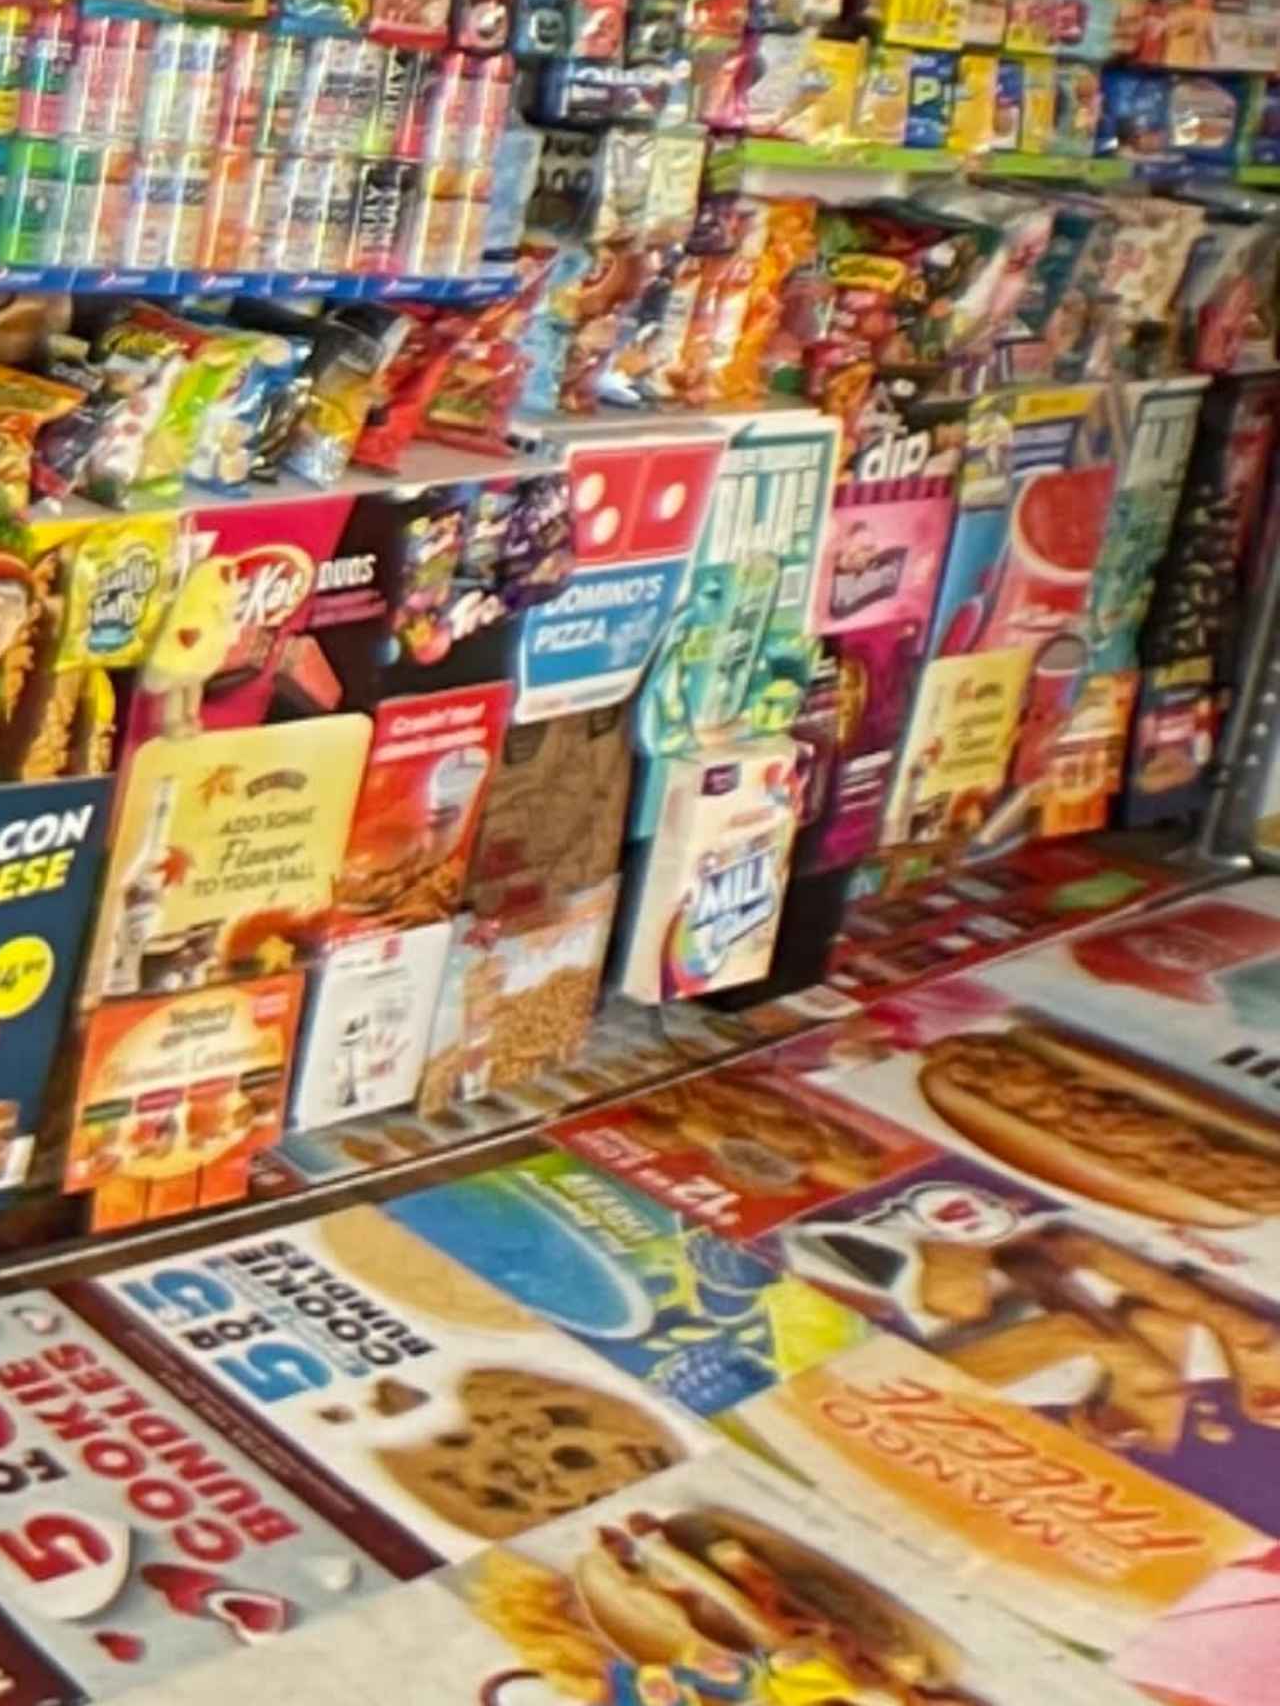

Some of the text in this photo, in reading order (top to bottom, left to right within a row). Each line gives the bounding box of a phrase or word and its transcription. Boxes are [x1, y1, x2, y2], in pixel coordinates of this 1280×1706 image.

[860, 426, 931, 483] dip
[318, 555, 377, 590] DUOS
[534, 617, 607, 655] PIZZA
[218, 836, 304, 874] Flavor
[230, 1248, 404, 1371] COOKIE
[267, 1239, 438, 1366] BUNDLES
[183, 1311, 279, 1354] FOR
[216, 1342, 333, 1403] 5
[44, 1341, 298, 1546] BUNDLES
